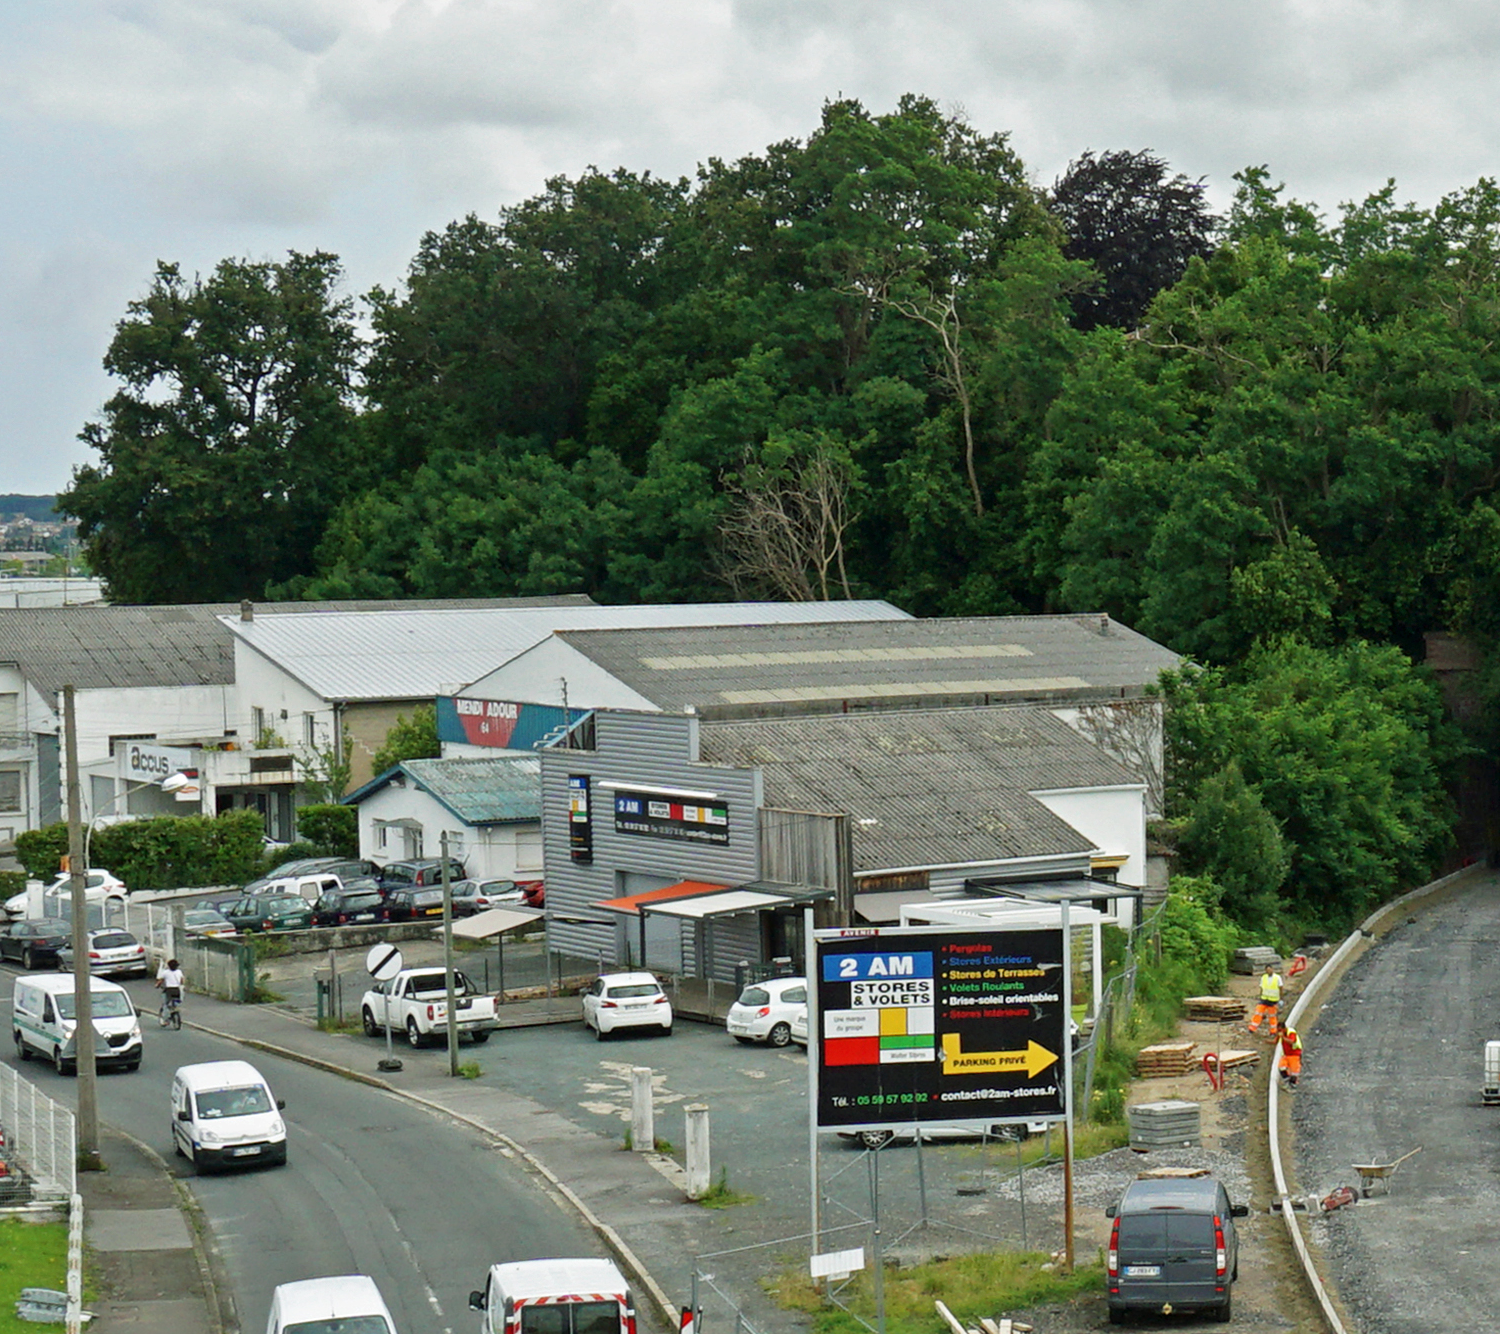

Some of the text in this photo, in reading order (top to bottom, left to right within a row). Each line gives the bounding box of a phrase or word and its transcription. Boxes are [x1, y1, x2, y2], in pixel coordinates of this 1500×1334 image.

[457, 699, 518, 719] MENDI ADOUR
[480, 721, 490, 734] 64
[618, 799, 639, 813] 2 AM
[949, 944, 993, 954] Pergolas
[840, 956, 913, 977] 2 AM
[949, 955, 1032, 966] Stores Extérieurs
[949, 969, 1045, 979] Stores de Terrasses
[853, 982, 930, 994] STORES
[949, 981, 1025, 992] Volets Roulants
[853, 993, 930, 1006] & VOLETS
[949, 992, 1059, 1006] Brise-soleil orientables
[949, 1010, 982, 1019] Stores
[953, 1055, 1027, 1067] PARKING PRIVÉ
[857, 1095, 870, 1105] 05
[871, 1094, 884, 1104] 59
[886, 1094, 899, 1104] 57
[941, 1086, 1057, 1101] contact@2am-stores.fr
